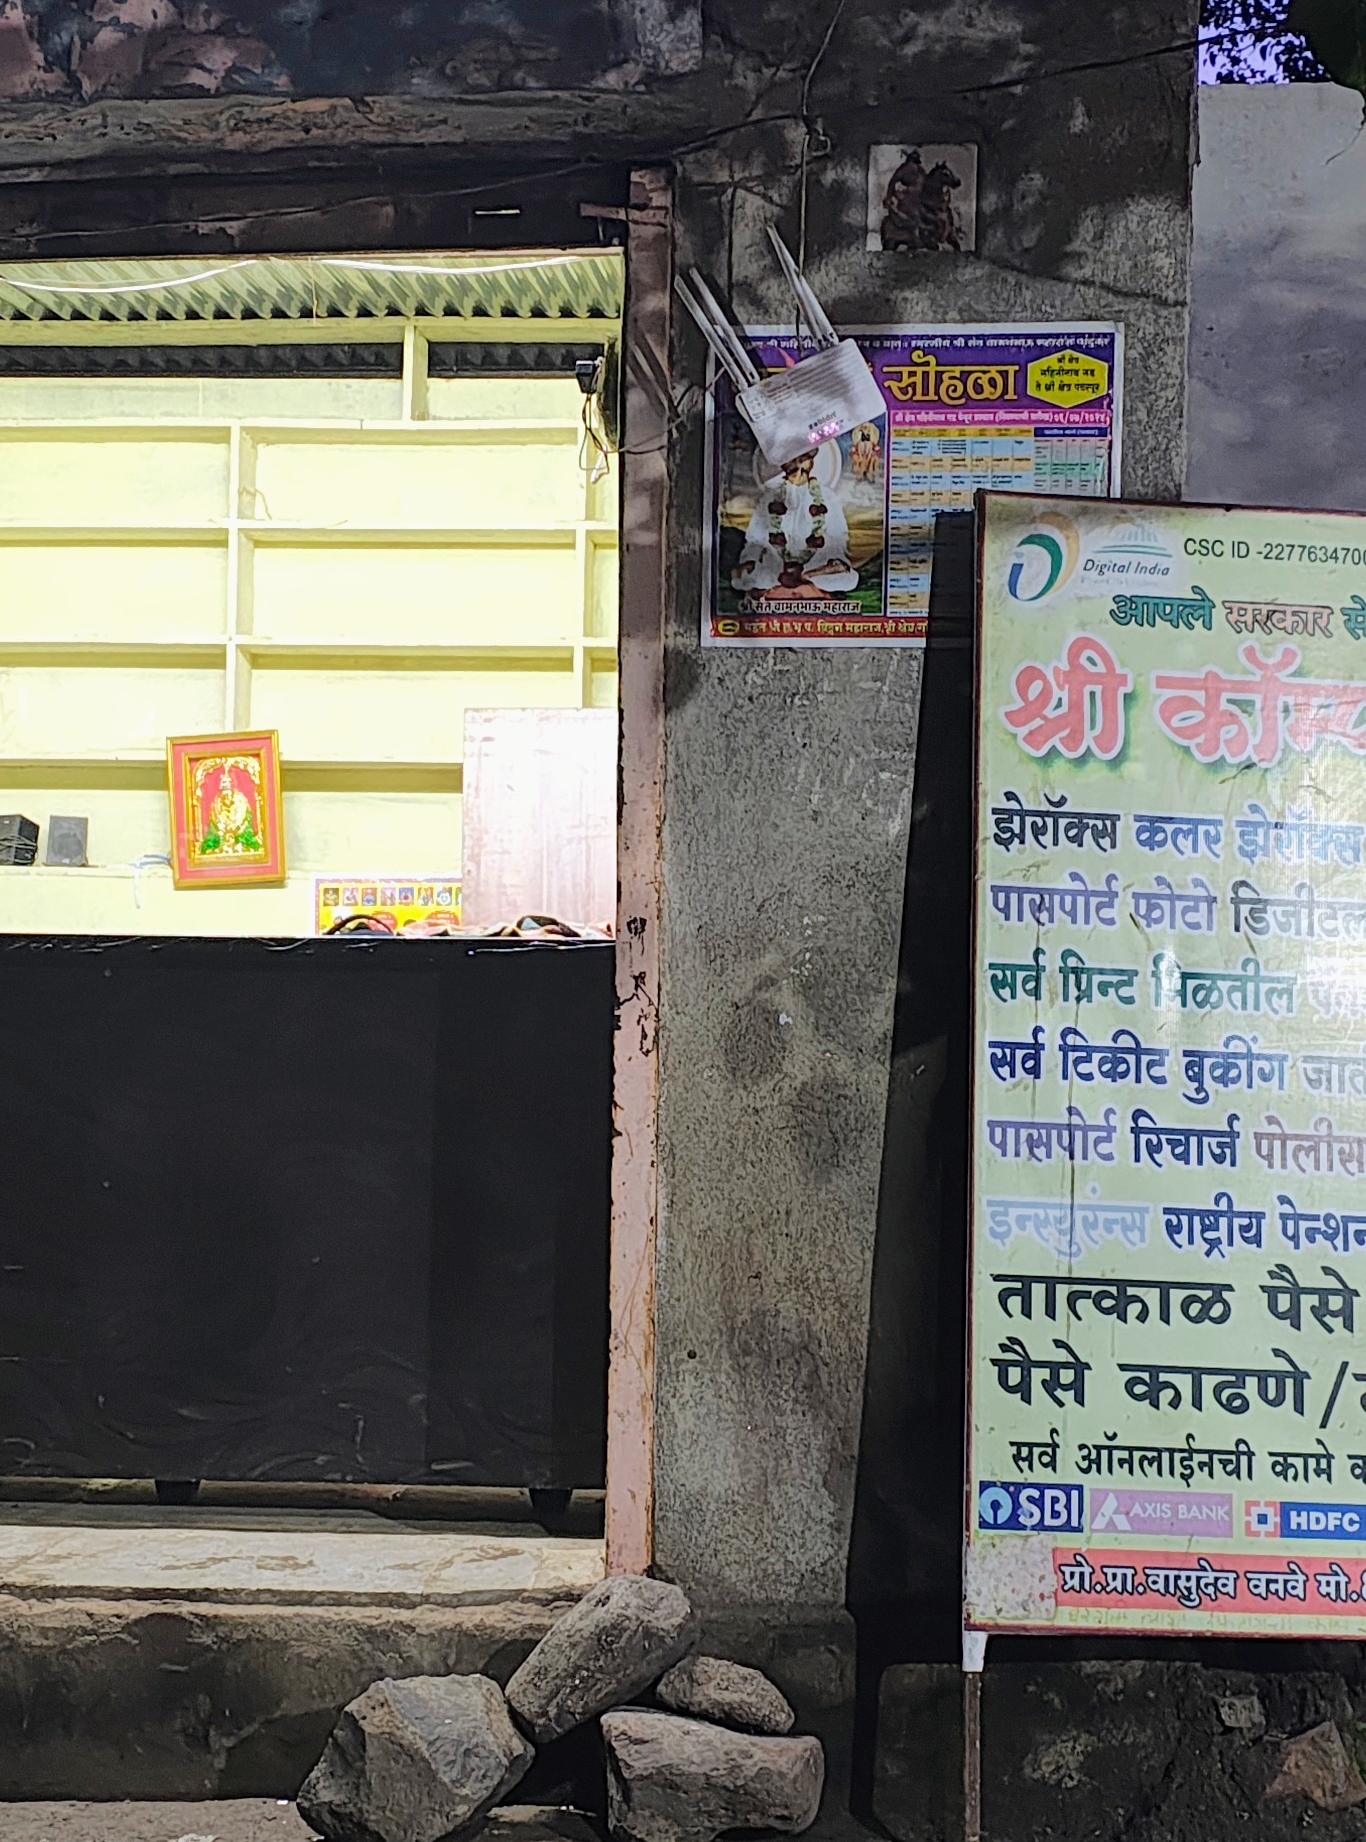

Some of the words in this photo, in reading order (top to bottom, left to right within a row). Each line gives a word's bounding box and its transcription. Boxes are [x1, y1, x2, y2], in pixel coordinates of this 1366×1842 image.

[882, 350, 1020, 406] सोहळा
[1083, 559, 1131, 577] Digital
[1134, 561, 1170, 577] India
[1184, 538, 1225, 558] CSC
[1232, 541, 1250, 558] ID
[1110, 587, 1213, 632] आपले
[1226, 600, 1333, 636] सरकार
[1002, 636, 1130, 760] श्री
[991, 793, 1120, 854] झेरॉक्स
[1135, 812, 1223, 859] कलर
[990, 872, 1118, 928] पासपोर्ट
[1134, 877, 1217, 935] फोटो
[989, 948, 1045, 1002] सर्व
[1059, 951, 1138, 1006] प्रिन्ट
[989, 1027, 1045, 1083] सर्व
[1059, 1028, 1169, 1087] टिकीट
[1181, 1035, 1288, 1105] बुकींग
[988, 1107, 1118, 1164] पासपोर्ट
[1131, 1109, 1241, 1169] रिचार्ज
[1254, 1116, 1366, 1176] पोलीस
[1163, 1193, 1267, 1262] राष्ट्रीय
[990, 1273, 1235, 1326] तात्काळ
[1259, 1263, 1361, 1334] पैसे
[990, 1337, 1093, 1411] पैसे
[1011, 1430, 1061, 1476] सर्व
[1076, 1432, 1254, 1489] ऑनलाईनची
[1270, 1438, 1335, 1485] कामे
[1017, 1489, 1081, 1530] SBI
[1129, 1500, 1172, 1519] AXIS
[1178, 1502, 1230, 1522] BANK
[1289, 1509, 1362, 1533] HDFC
